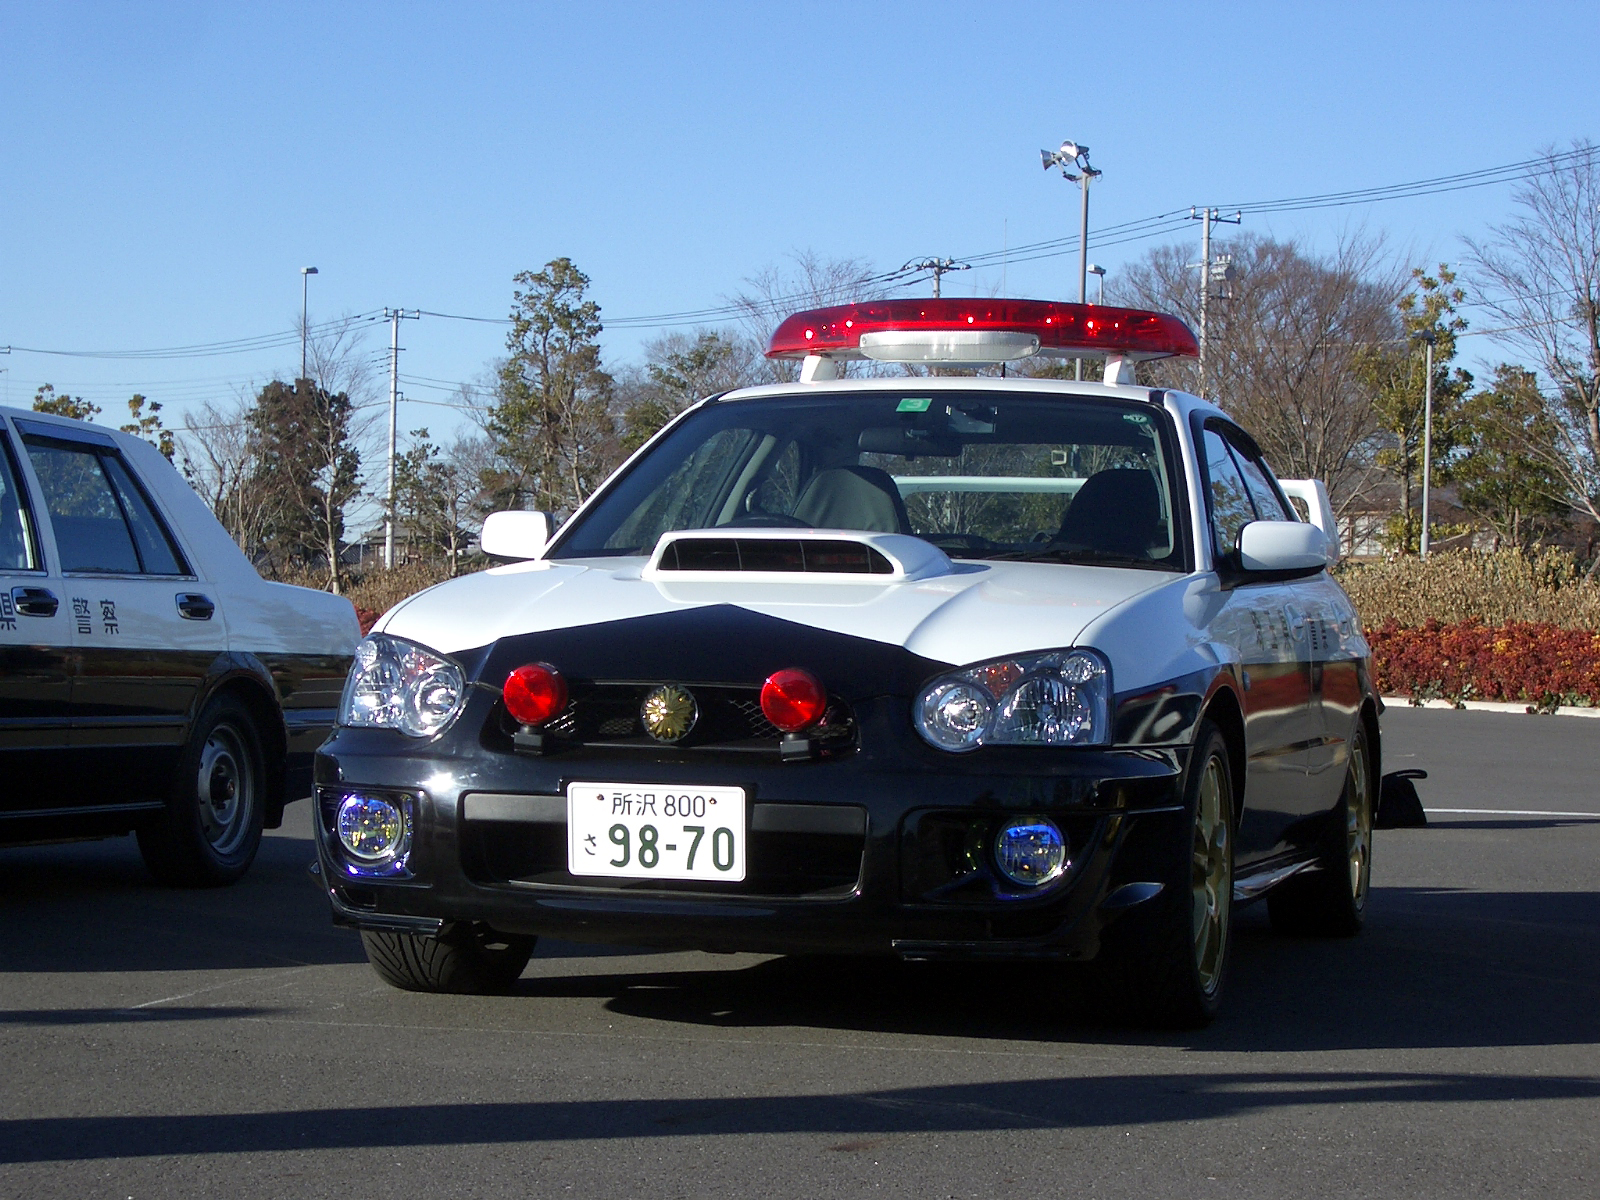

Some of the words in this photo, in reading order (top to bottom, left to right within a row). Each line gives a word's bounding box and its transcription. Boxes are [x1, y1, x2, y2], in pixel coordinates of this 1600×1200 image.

[612, 792, 658, 816] 所沢
[664, 794, 706, 818] 800
[584, 833, 598, 856] さ
[608, 823, 735, 872] 98-70
